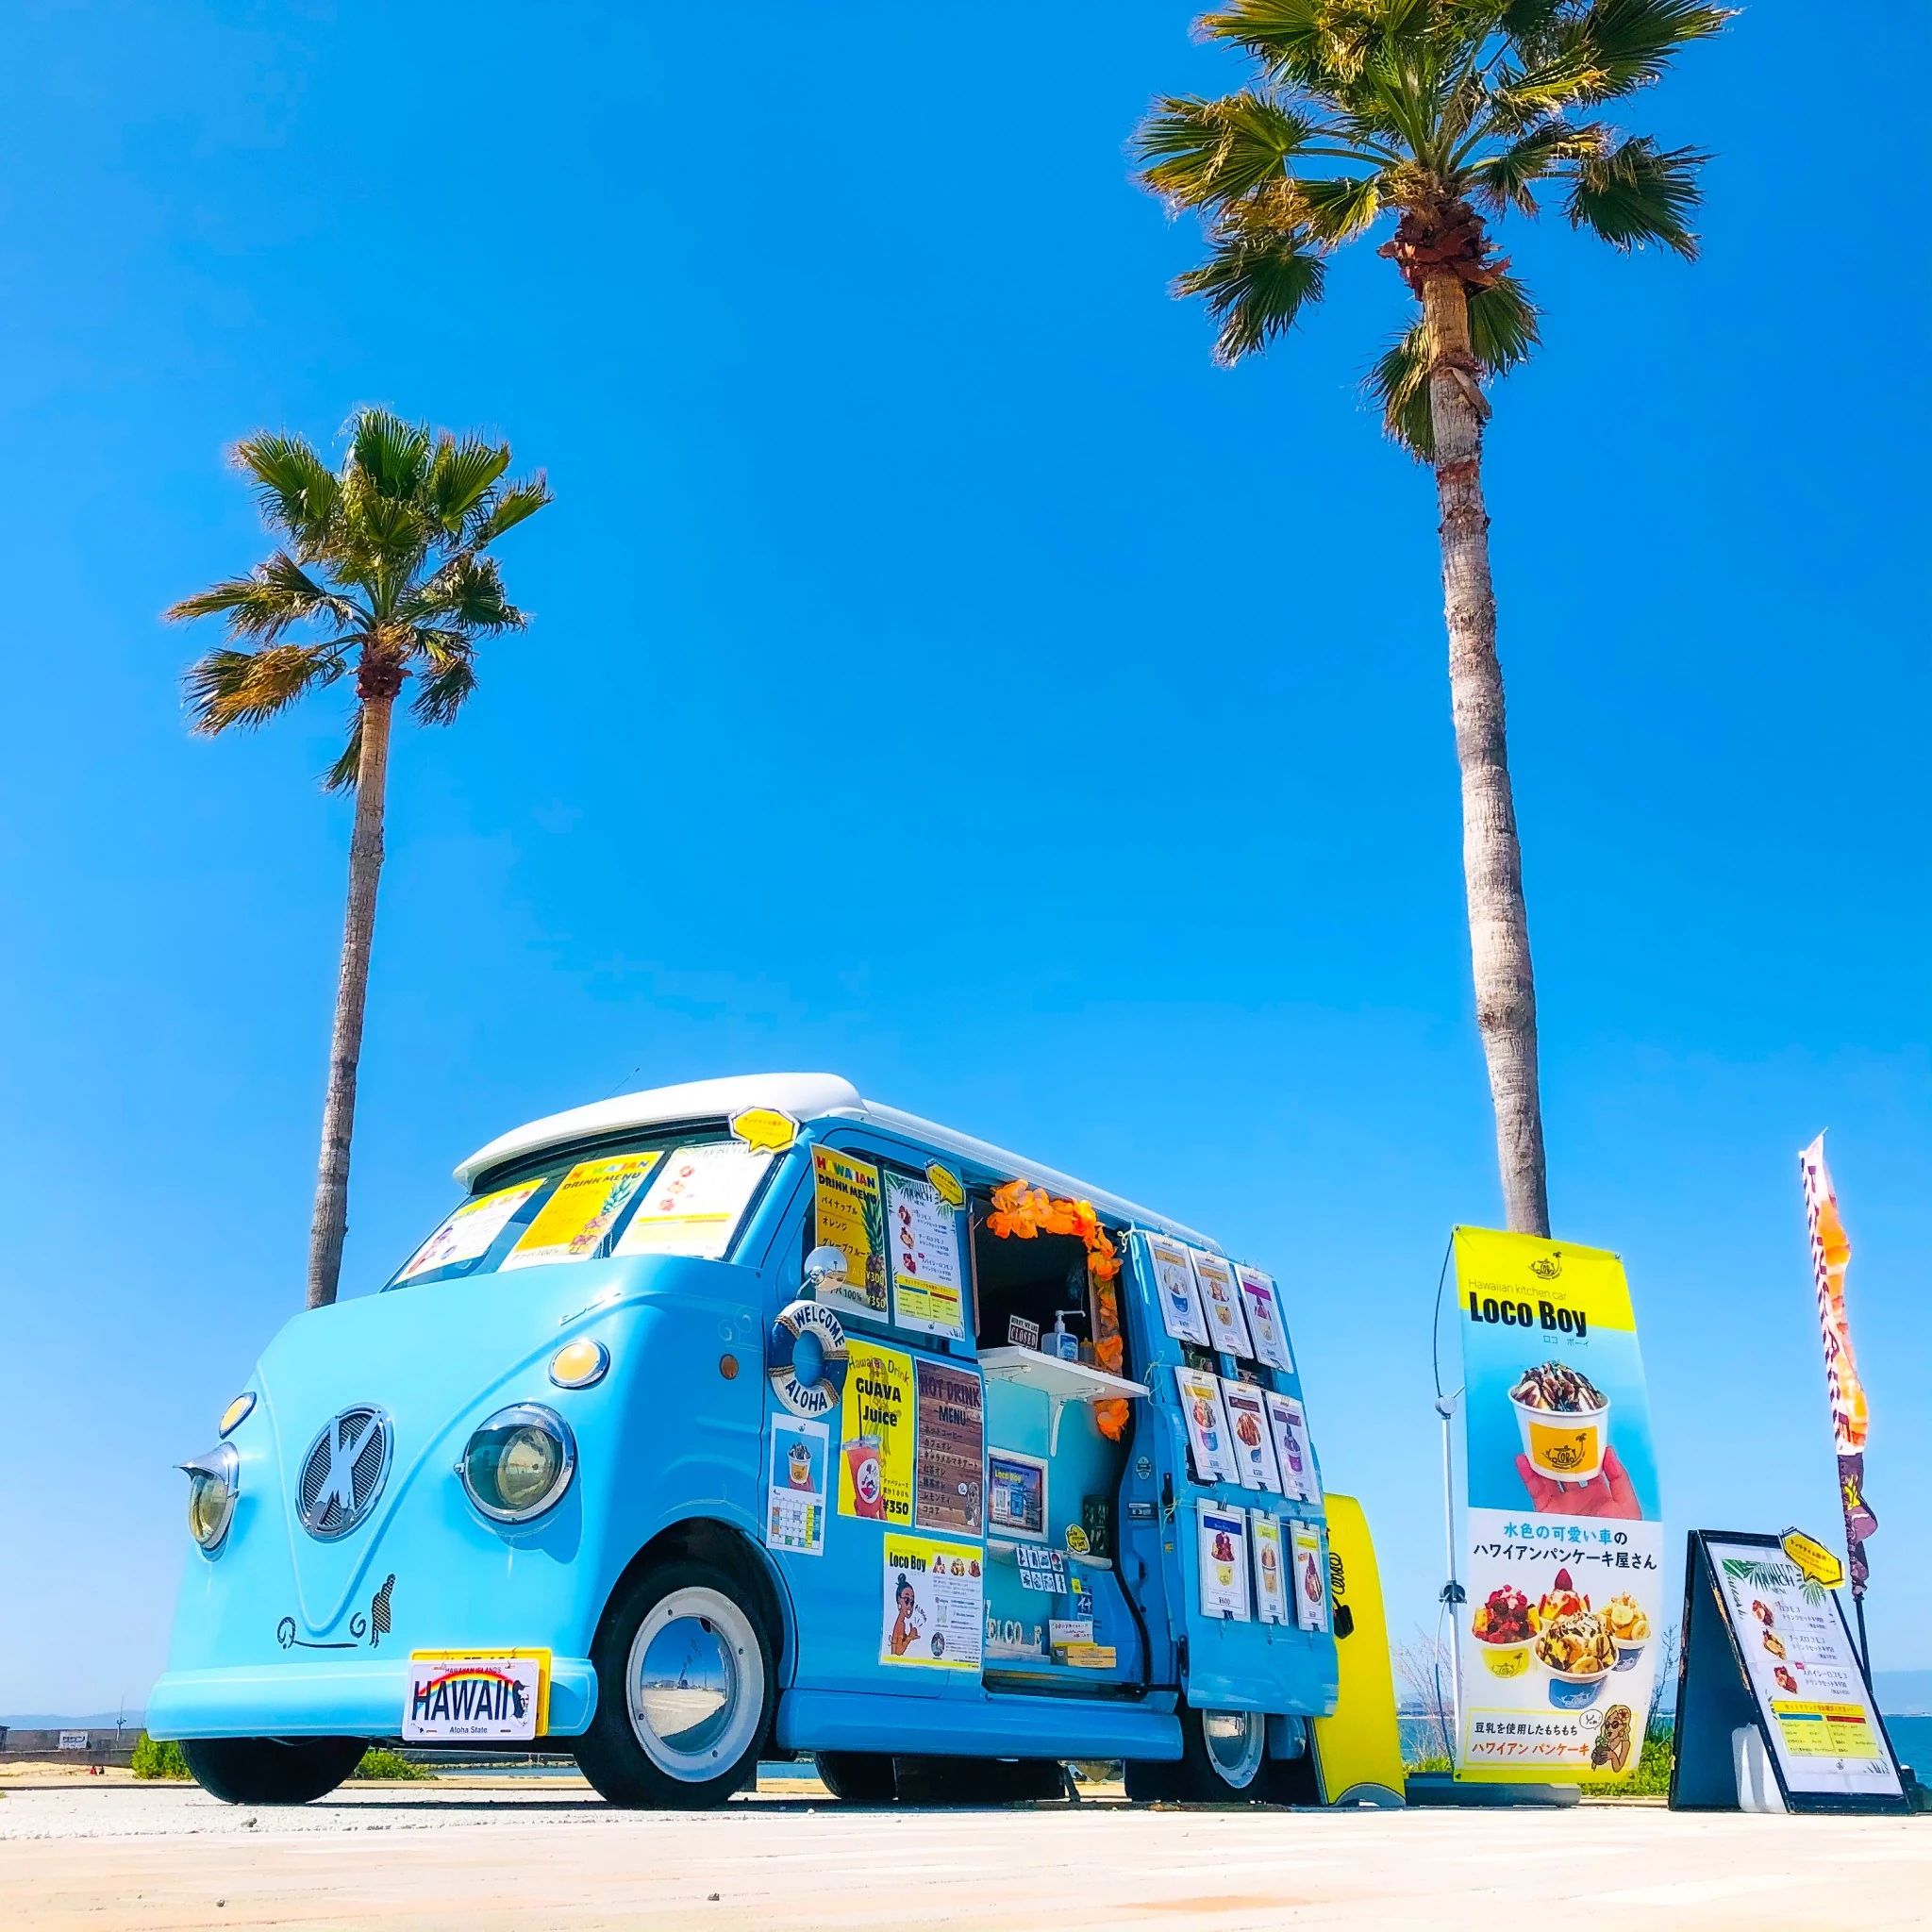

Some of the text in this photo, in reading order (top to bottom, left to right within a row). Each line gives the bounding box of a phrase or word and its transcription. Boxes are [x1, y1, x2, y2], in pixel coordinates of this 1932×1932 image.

[563, 1172, 642, 1190] DRINK MENU
[818, 1174, 877, 1204] DRINK MENU
[822, 1196, 858, 1215] パイナップル
[822, 1216, 847, 1232] オレンジ
[1468, 1278, 1567, 1301] Hawaiian kitchen car
[1469, 1291, 1588, 1338] Loco Boy
[793, 1306, 845, 1348] WELCOME
[1010, 1326, 1036, 1346] CLOSED
[1542, 1335, 1589, 1349] ロコ ボーイ
[888, 1358, 910, 1386] Drink
[785, 1380, 828, 1412] ALOHA
[856, 1377, 902, 1403] GUAVA
[920, 1374, 982, 1408] HOT DRINK
[862, 1406, 898, 1427] Juice
[939, 1406, 967, 1426] MENU
[883, 1499, 909, 1516] ¥350
[1504, 1522, 1627, 1546] 水色の可愛い車の
[890, 1552, 926, 1574] Loco Boy
[1474, 1542, 1657, 1571] ハワイアンパンケーキ屋さん
[411, 1680, 509, 1721] HAWAII
[470, 1725, 488, 1734] State
[1474, 1722, 1578, 1737] 豆乳を使用したもちもち
